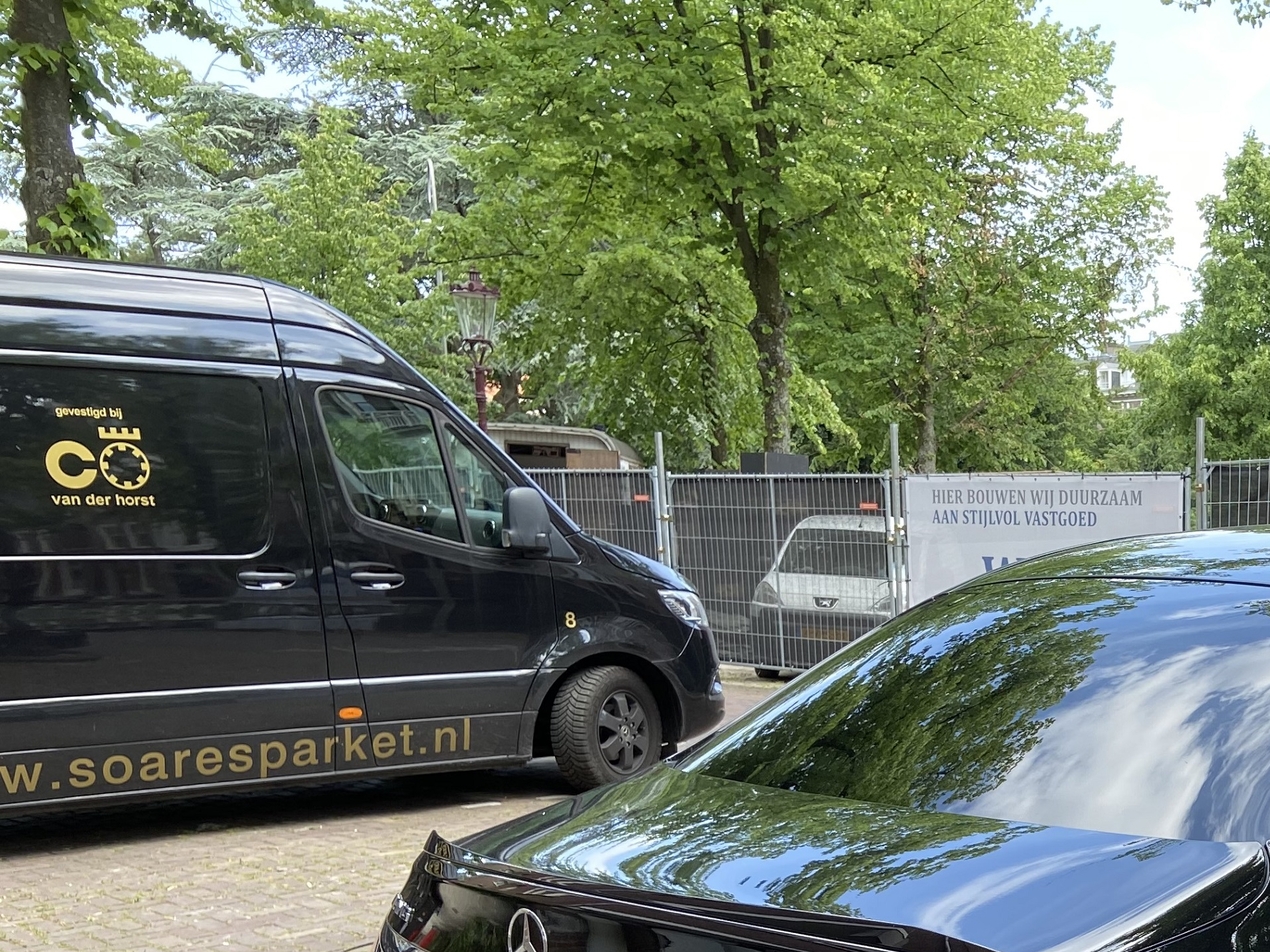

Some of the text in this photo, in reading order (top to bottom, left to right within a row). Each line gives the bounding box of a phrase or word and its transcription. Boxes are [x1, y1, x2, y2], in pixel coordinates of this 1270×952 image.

[55, 406, 123, 420] gevestigd bij
[51, 493, 156, 507] van der horst
[932, 489, 1143, 509] HIER BOUWEN WIJ DUURZAAM
[932, 509, 1098, 529] AAN STIJLVOL VASTGOED
[565, 611, 577, 628] 8
